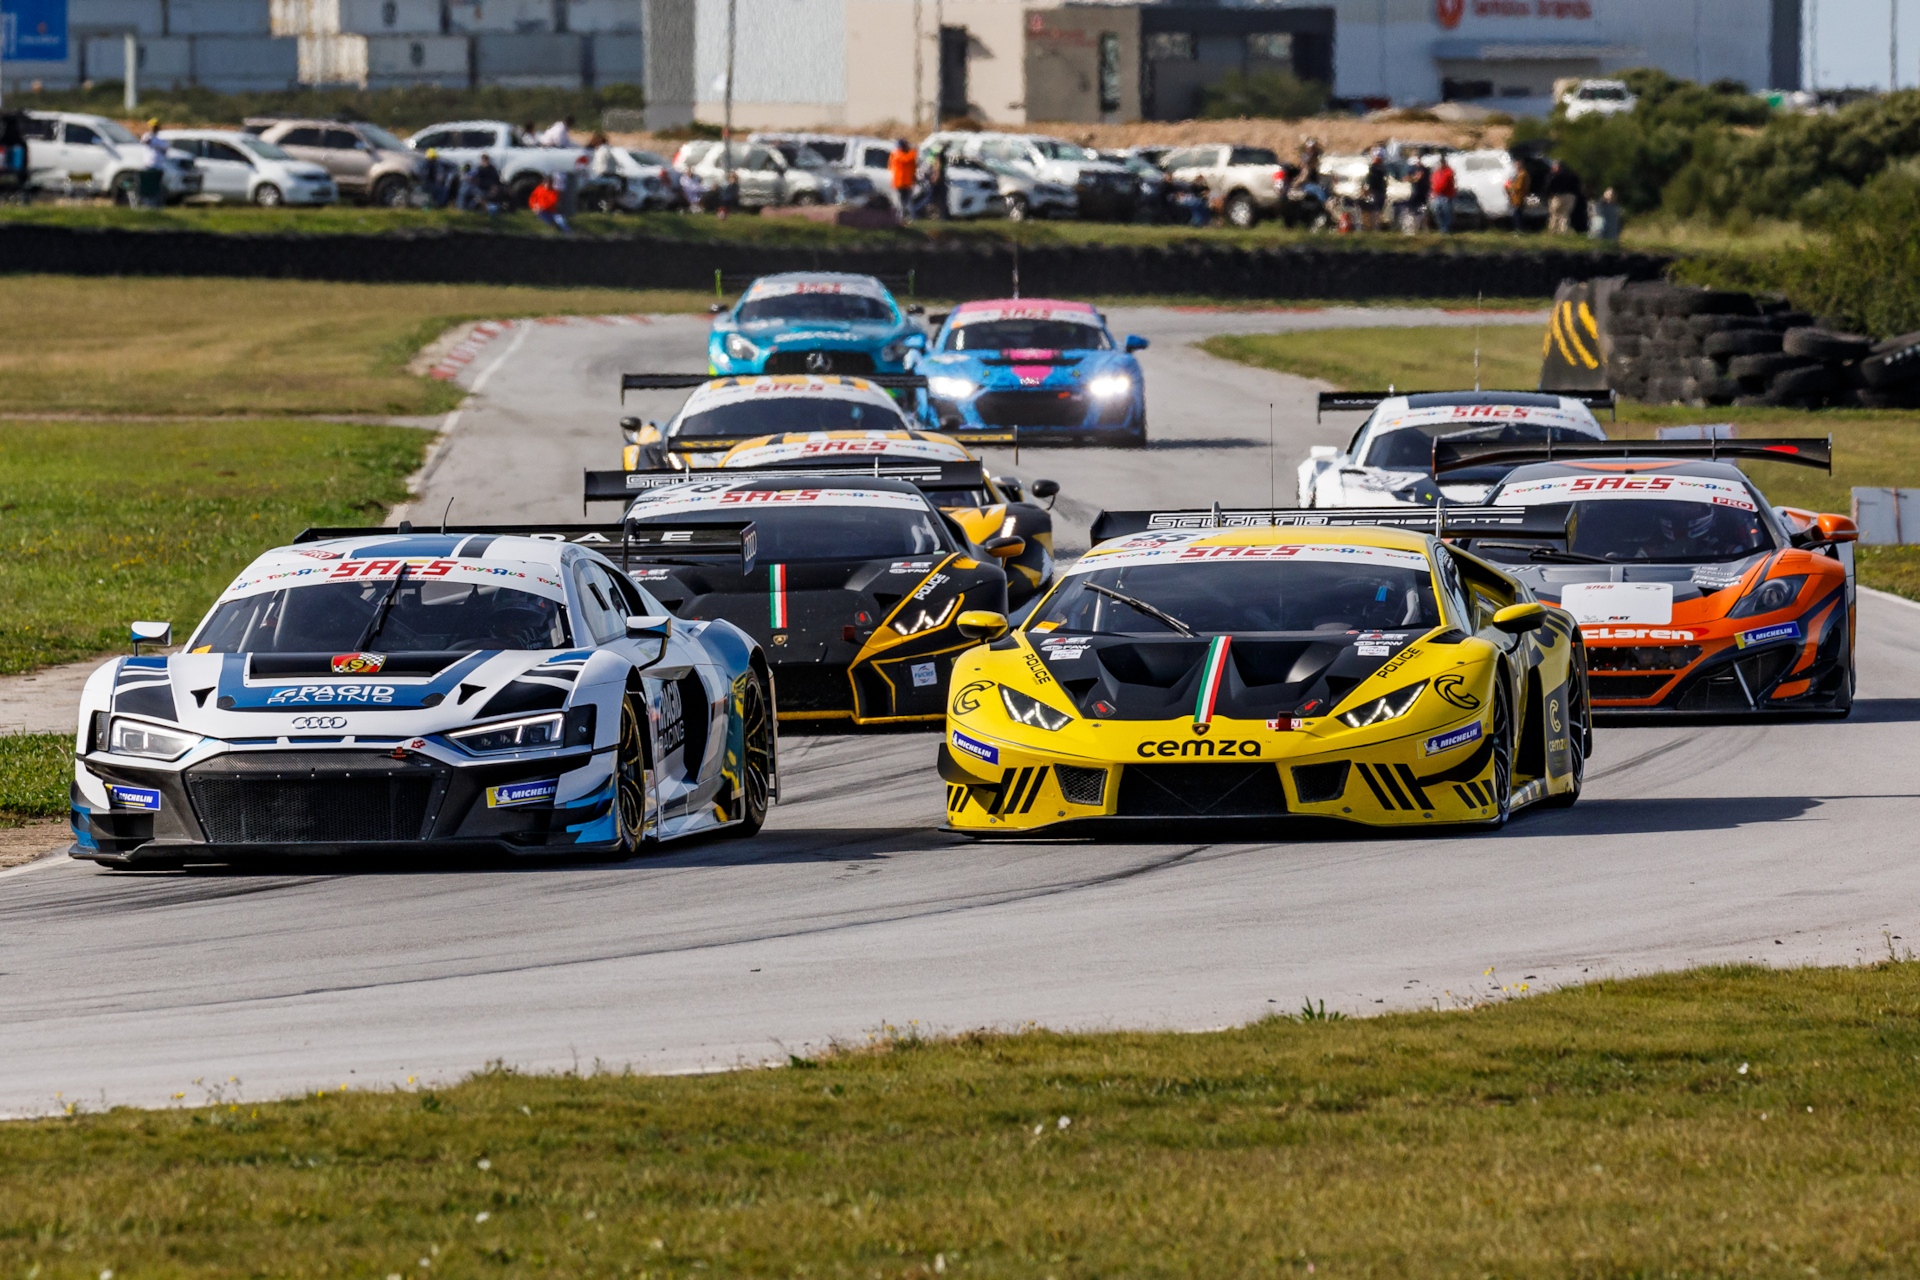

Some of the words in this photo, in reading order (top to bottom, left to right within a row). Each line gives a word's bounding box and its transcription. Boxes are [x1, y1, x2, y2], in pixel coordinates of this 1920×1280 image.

[1451, 406, 1531, 419] SAES
[802, 441, 890, 453] SAES
[1569, 477, 1675, 491] SAES
[719, 489, 823, 503] SAES
[1716, 498, 1750, 509] PRO
[1179, 545, 1306, 558] SAES
[329, 560, 459, 578] SAES
[913, 572, 947, 601] POLICE
[1581, 628, 1694, 641] cLaren
[1755, 627, 1793, 640] MICHELIN
[350, 660, 365, 670] S
[1022, 653, 1051, 685] POLICE
[1376, 647, 1420, 679] POLICE
[299, 685, 395, 696] PAGID
[267, 694, 393, 704] RACING
[659, 719, 685, 750] RACING
[1440, 728, 1478, 748] MICHELIN
[957, 738, 992, 758] MICHELIN
[1136, 739, 1262, 758] cemza
[119, 792, 154, 803] MICHELIN
[511, 786, 557, 799] MICHELIN
